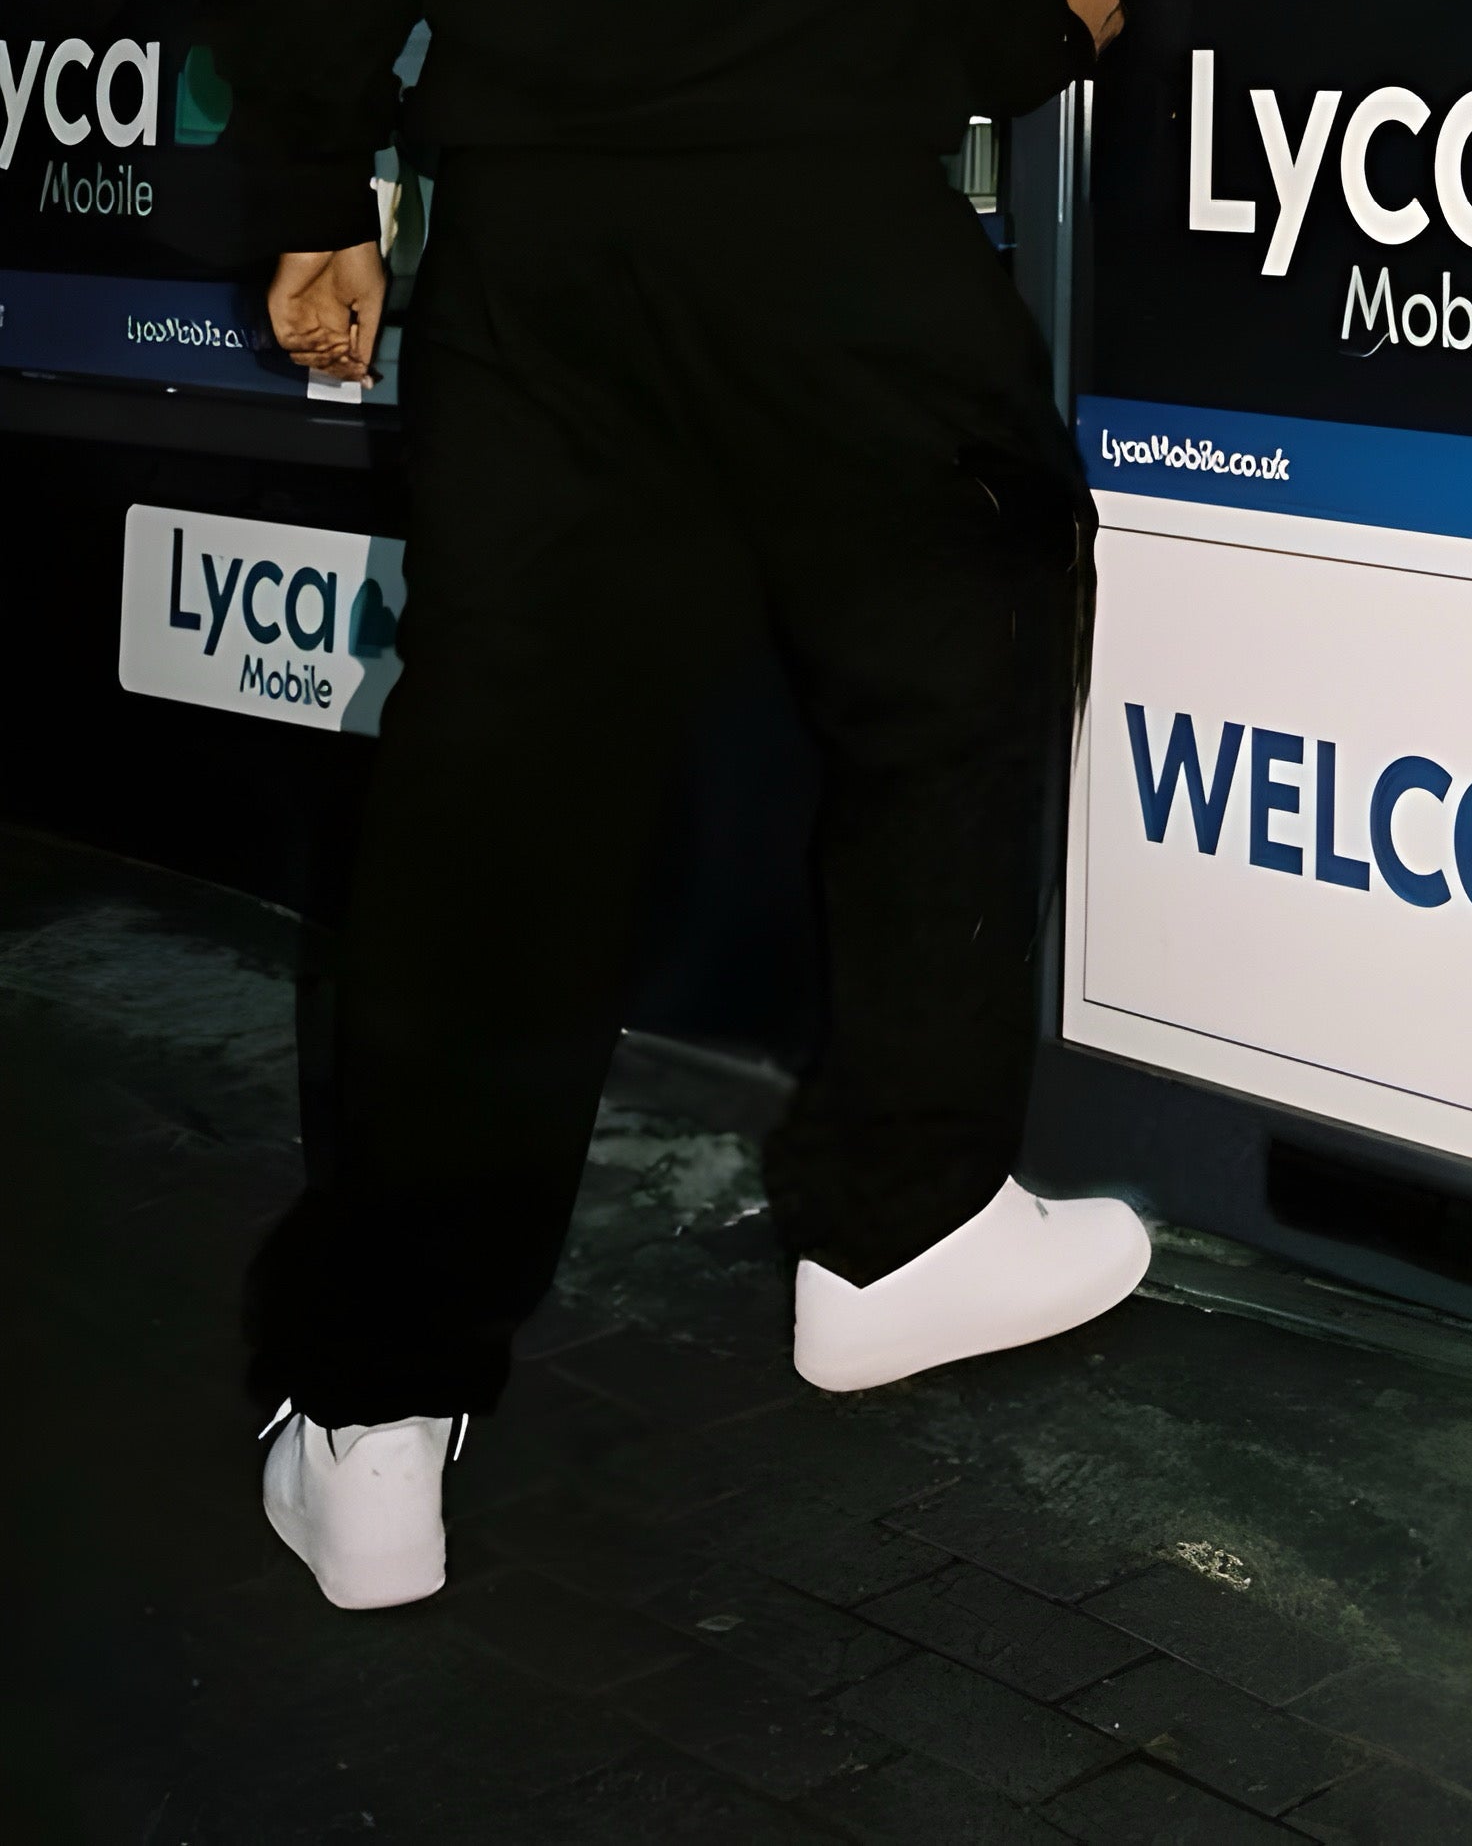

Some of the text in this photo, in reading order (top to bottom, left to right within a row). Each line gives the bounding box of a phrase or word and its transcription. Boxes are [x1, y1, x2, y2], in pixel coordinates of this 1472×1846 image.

[39, 159, 153, 216] Mobile
[169, 527, 338, 656] Lyca
[239, 653, 333, 709] Mobile
